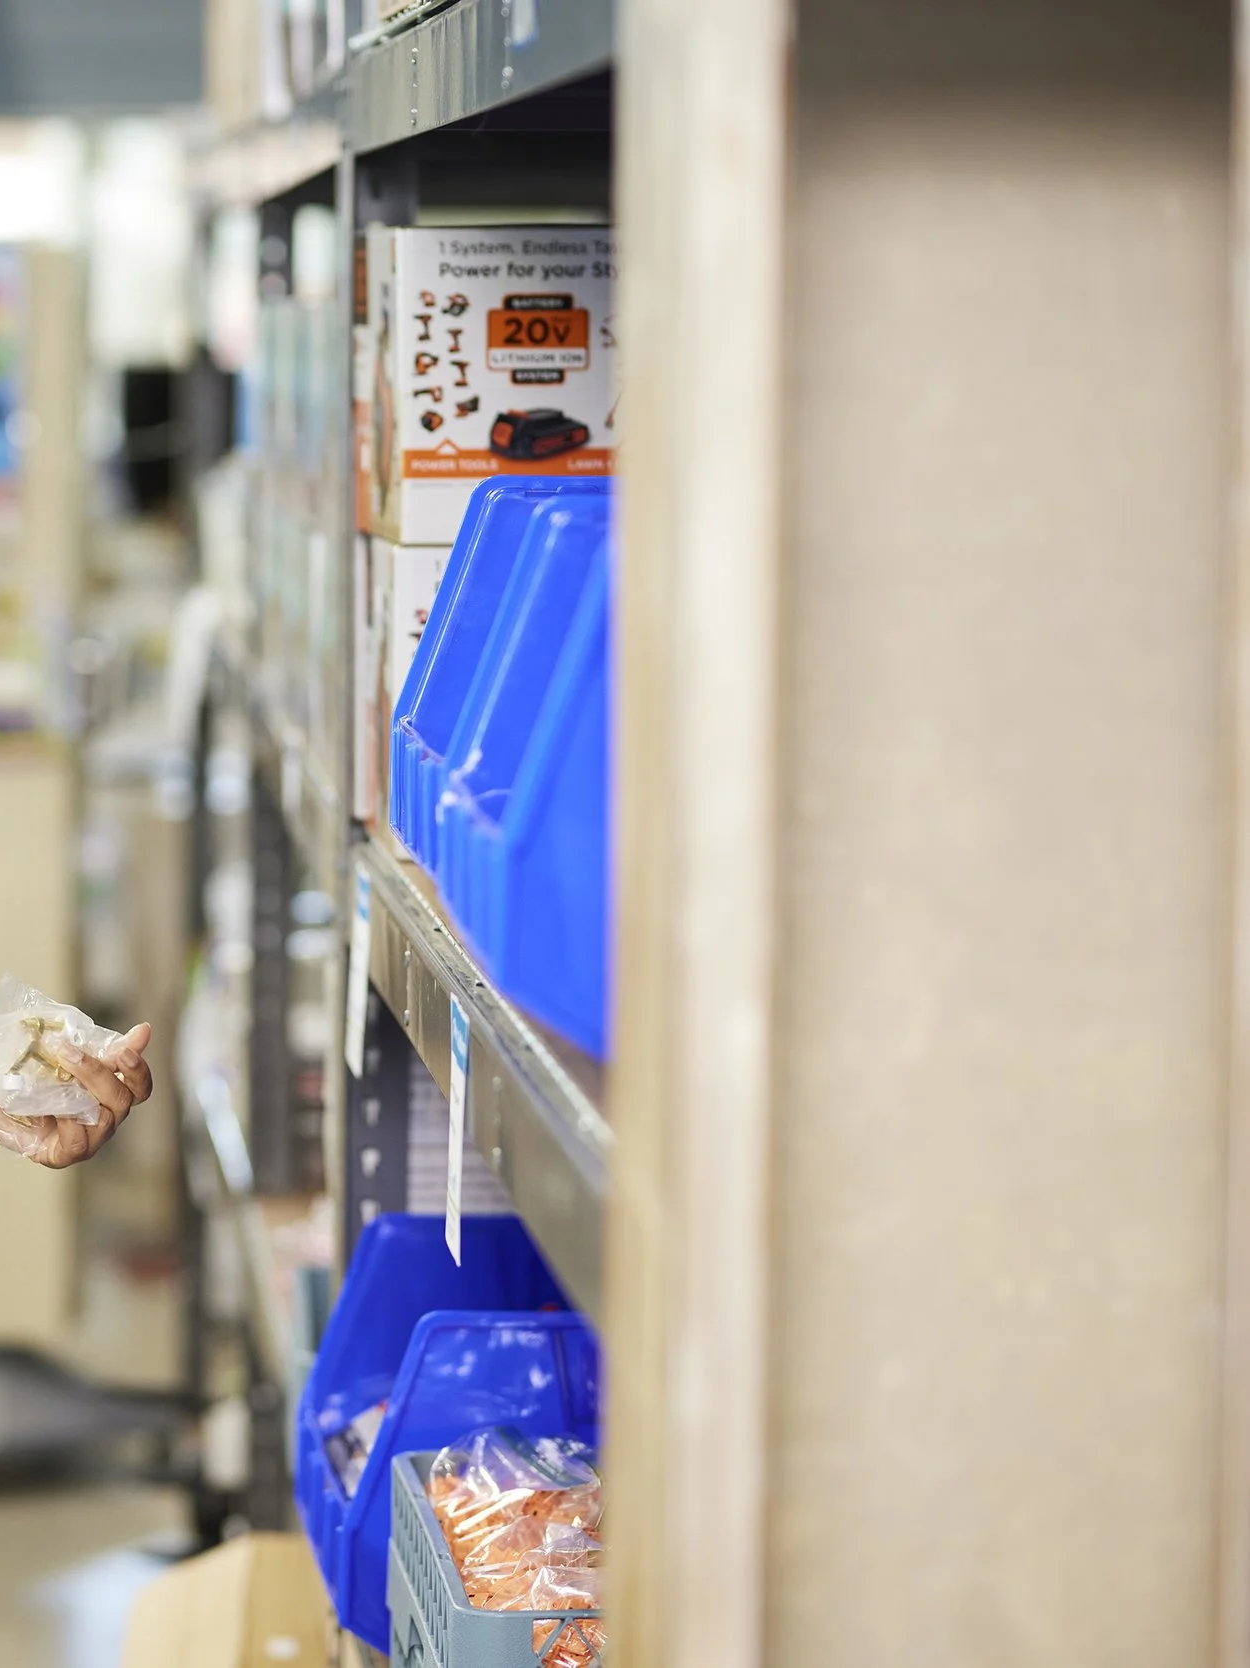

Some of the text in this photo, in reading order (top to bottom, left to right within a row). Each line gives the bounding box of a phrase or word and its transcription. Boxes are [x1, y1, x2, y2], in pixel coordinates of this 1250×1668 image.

[522, 239, 588, 255] Endless
[439, 262, 500, 278] Power
[507, 261, 535, 278] for
[540, 264, 586, 280] your
[411, 459, 499, 471] POWER TOOLS
